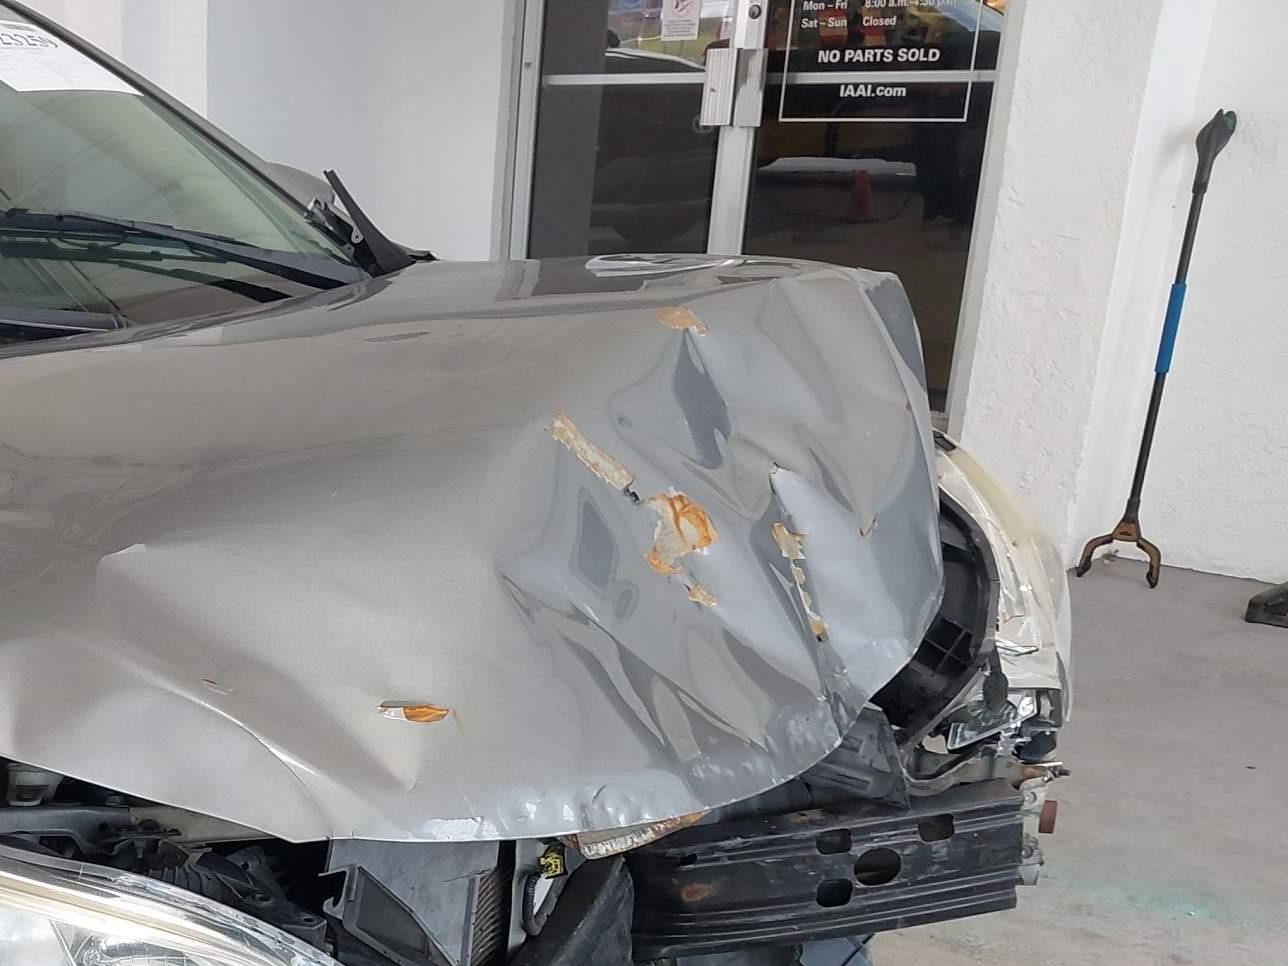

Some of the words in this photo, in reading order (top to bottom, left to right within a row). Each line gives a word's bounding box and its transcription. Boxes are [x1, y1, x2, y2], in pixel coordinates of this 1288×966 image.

[803, 0, 825, 10] Mon
[835, 0, 848, 10] Fri
[801, 17, 818, 29] Sat
[827, 17, 848, 27] Sun
[862, 15, 897, 26] Closed
[818, 50, 840, 63] NO
[844, 49, 893, 62] PARTS
[897, 48, 940, 62] SOLD
[839, 84, 907, 97] IAAI.com
